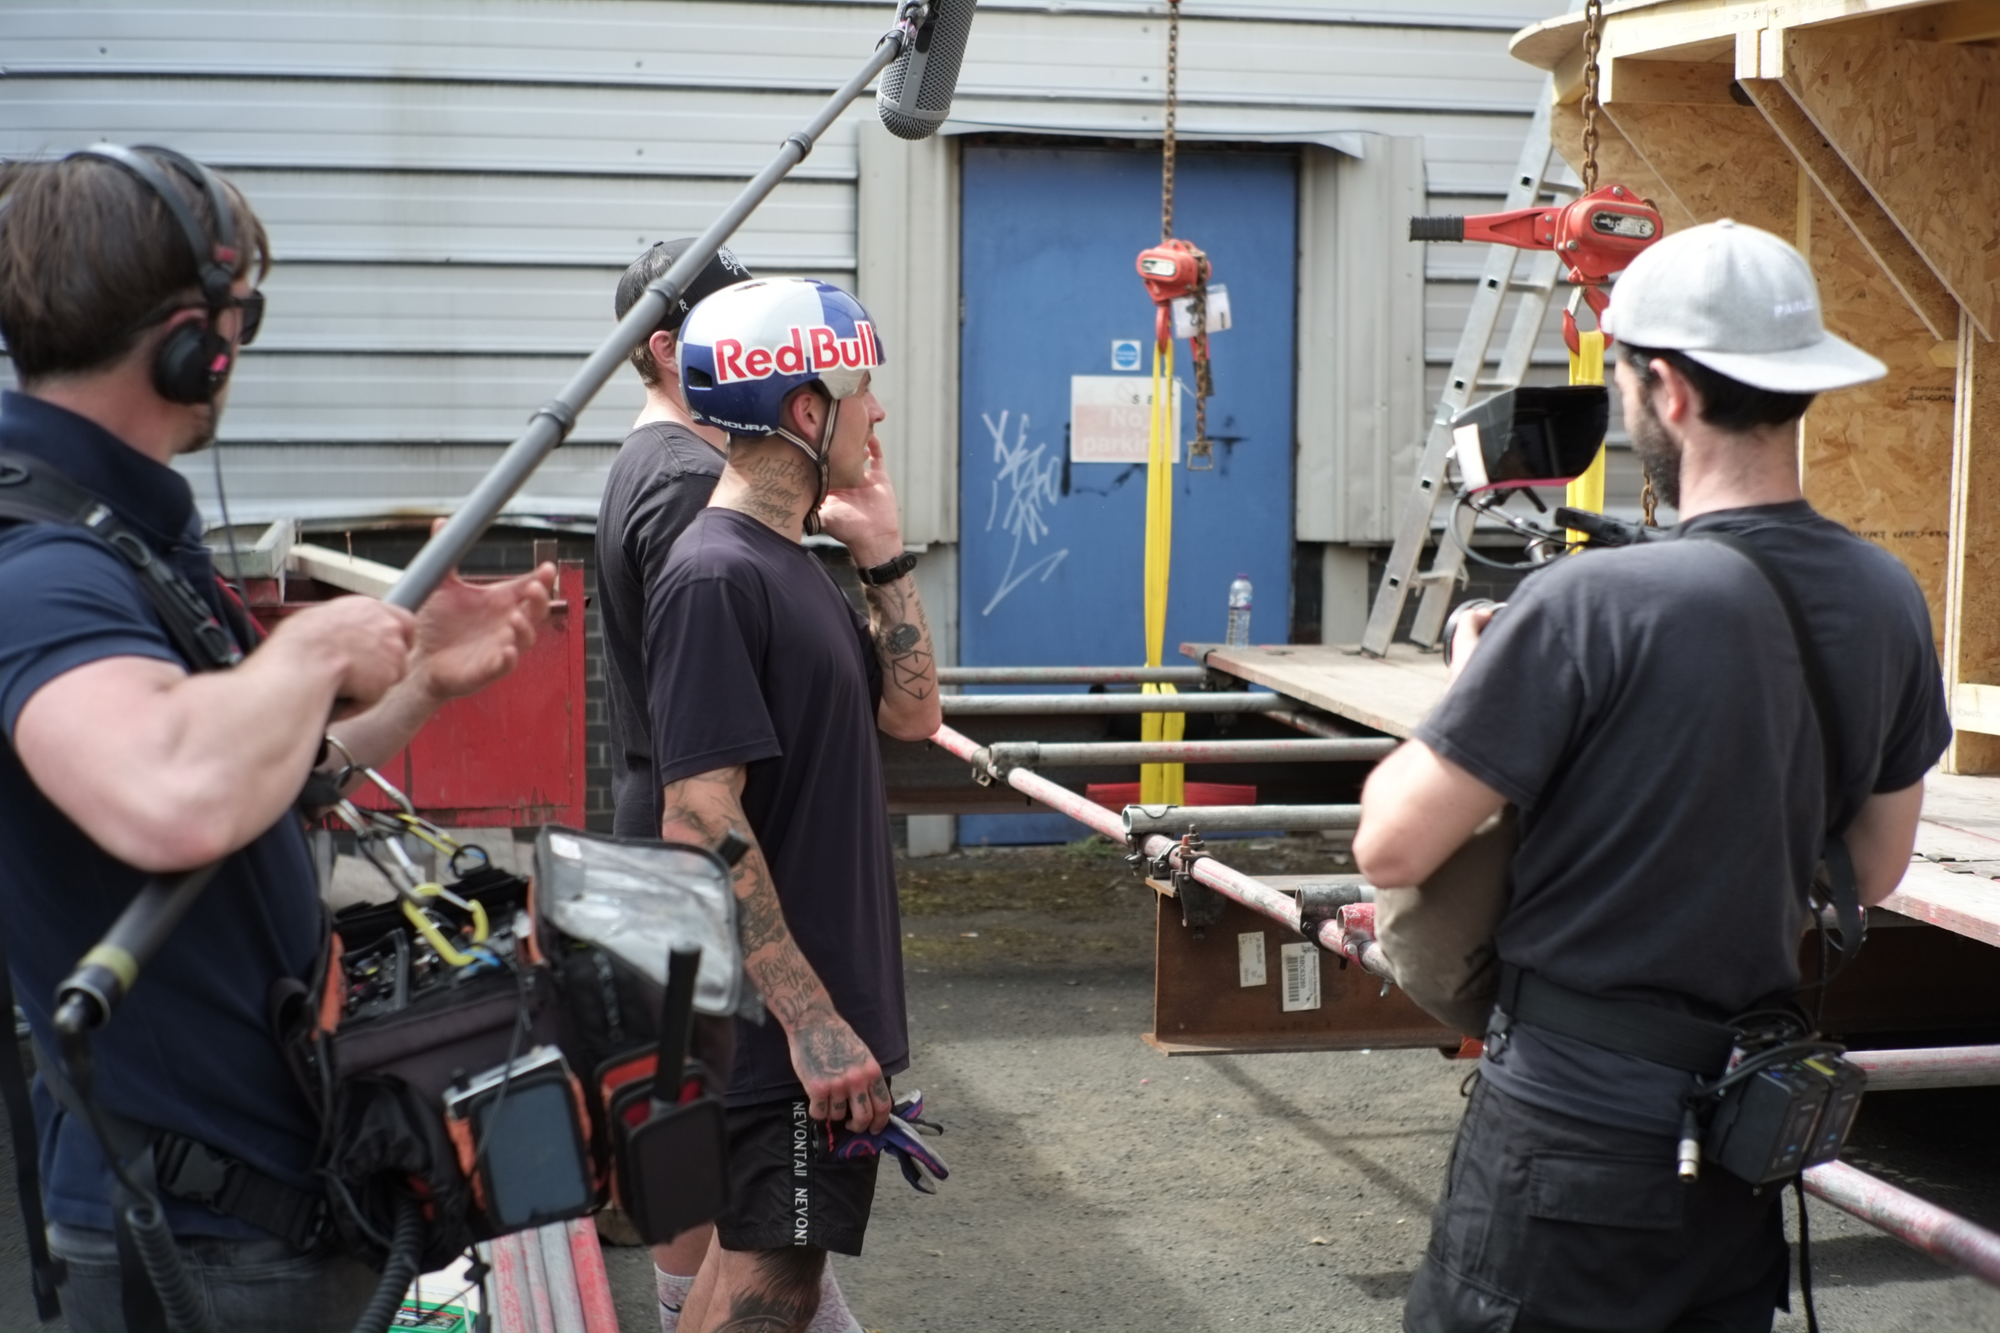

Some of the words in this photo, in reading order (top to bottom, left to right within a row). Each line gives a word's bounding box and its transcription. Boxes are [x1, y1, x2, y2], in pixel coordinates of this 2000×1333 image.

[715, 327, 805, 382] Red
[808, 323, 877, 370] Bull
[708, 415, 772, 431] ENDURA
